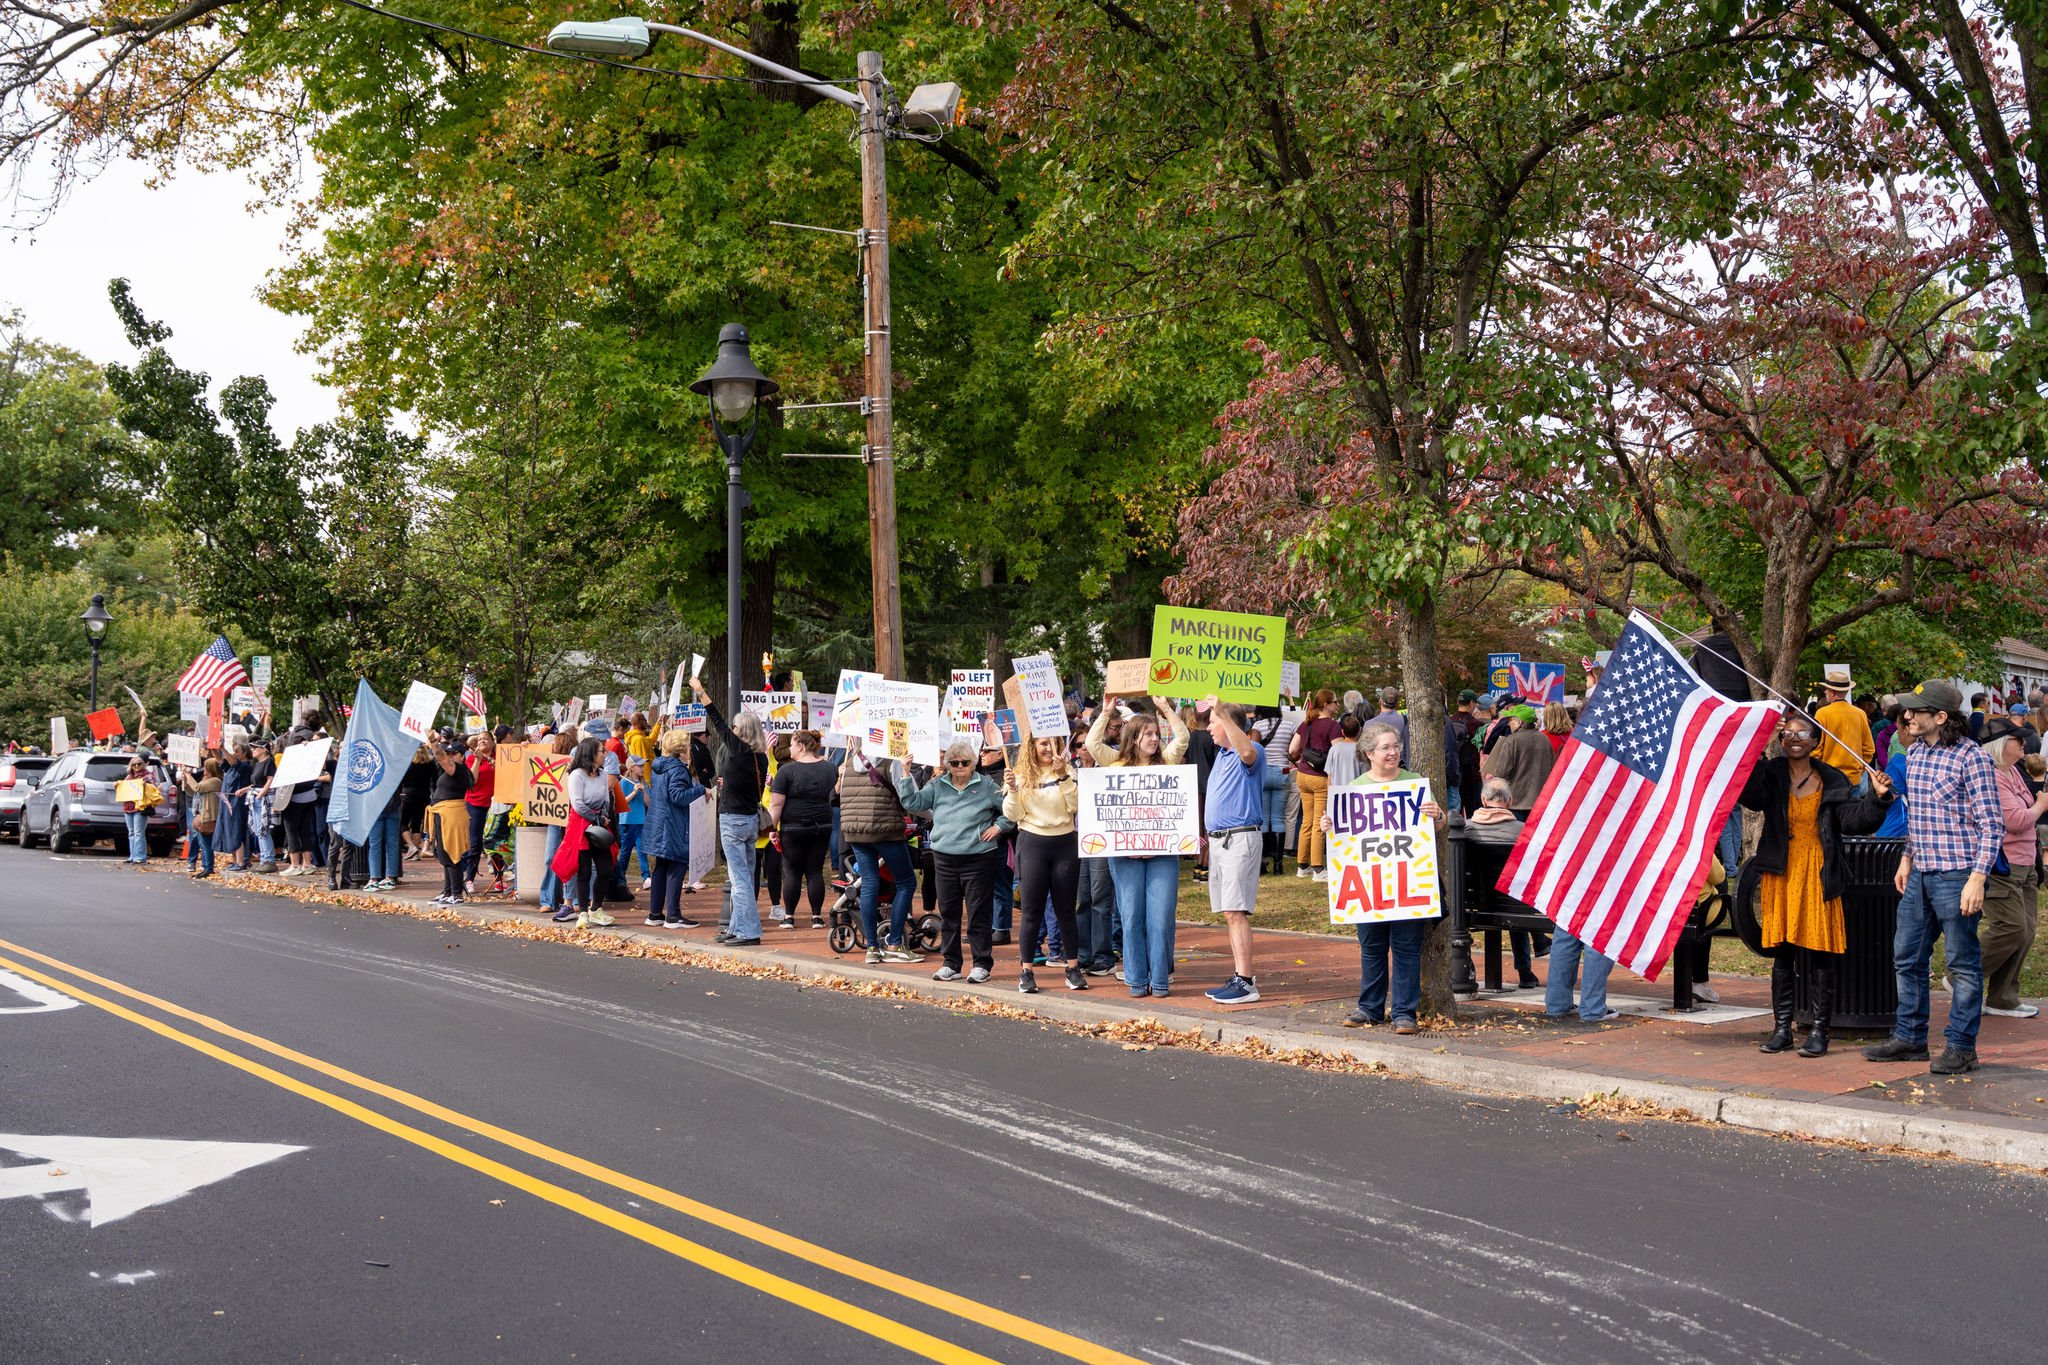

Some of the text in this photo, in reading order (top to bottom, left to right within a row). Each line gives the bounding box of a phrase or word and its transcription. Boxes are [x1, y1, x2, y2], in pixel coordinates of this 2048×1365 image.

[1170, 617, 1267, 645] MARCHING
[1168, 641, 1263, 665] FOR MY KIDS
[1491, 657, 1503, 667] IKEA
[953, 672, 992, 683] NO LEFT
[1179, 667, 1209, 682] AND
[1216, 670, 1263, 689] YOURS
[1493, 672, 1510, 684] BETTE
[740, 694, 796, 704] LONG LIVE
[953, 686, 967, 696] NO
[967, 686, 994, 696] RIGHT
[1029, 689, 1055, 701] 1776
[962, 710, 987, 720] MU
[404, 716, 422, 734] ALL
[955, 723, 983, 732] UNITE
[500, 745, 523, 766] NO
[1105, 773, 1179, 790] IF THIS WAS
[536, 786, 558, 804] NO
[528, 800, 569, 820] KINGS
[1332, 786, 1426, 836] LIBERTY
[1361, 835, 1414, 862] FOR
[1335, 860, 1431, 913] ALL
